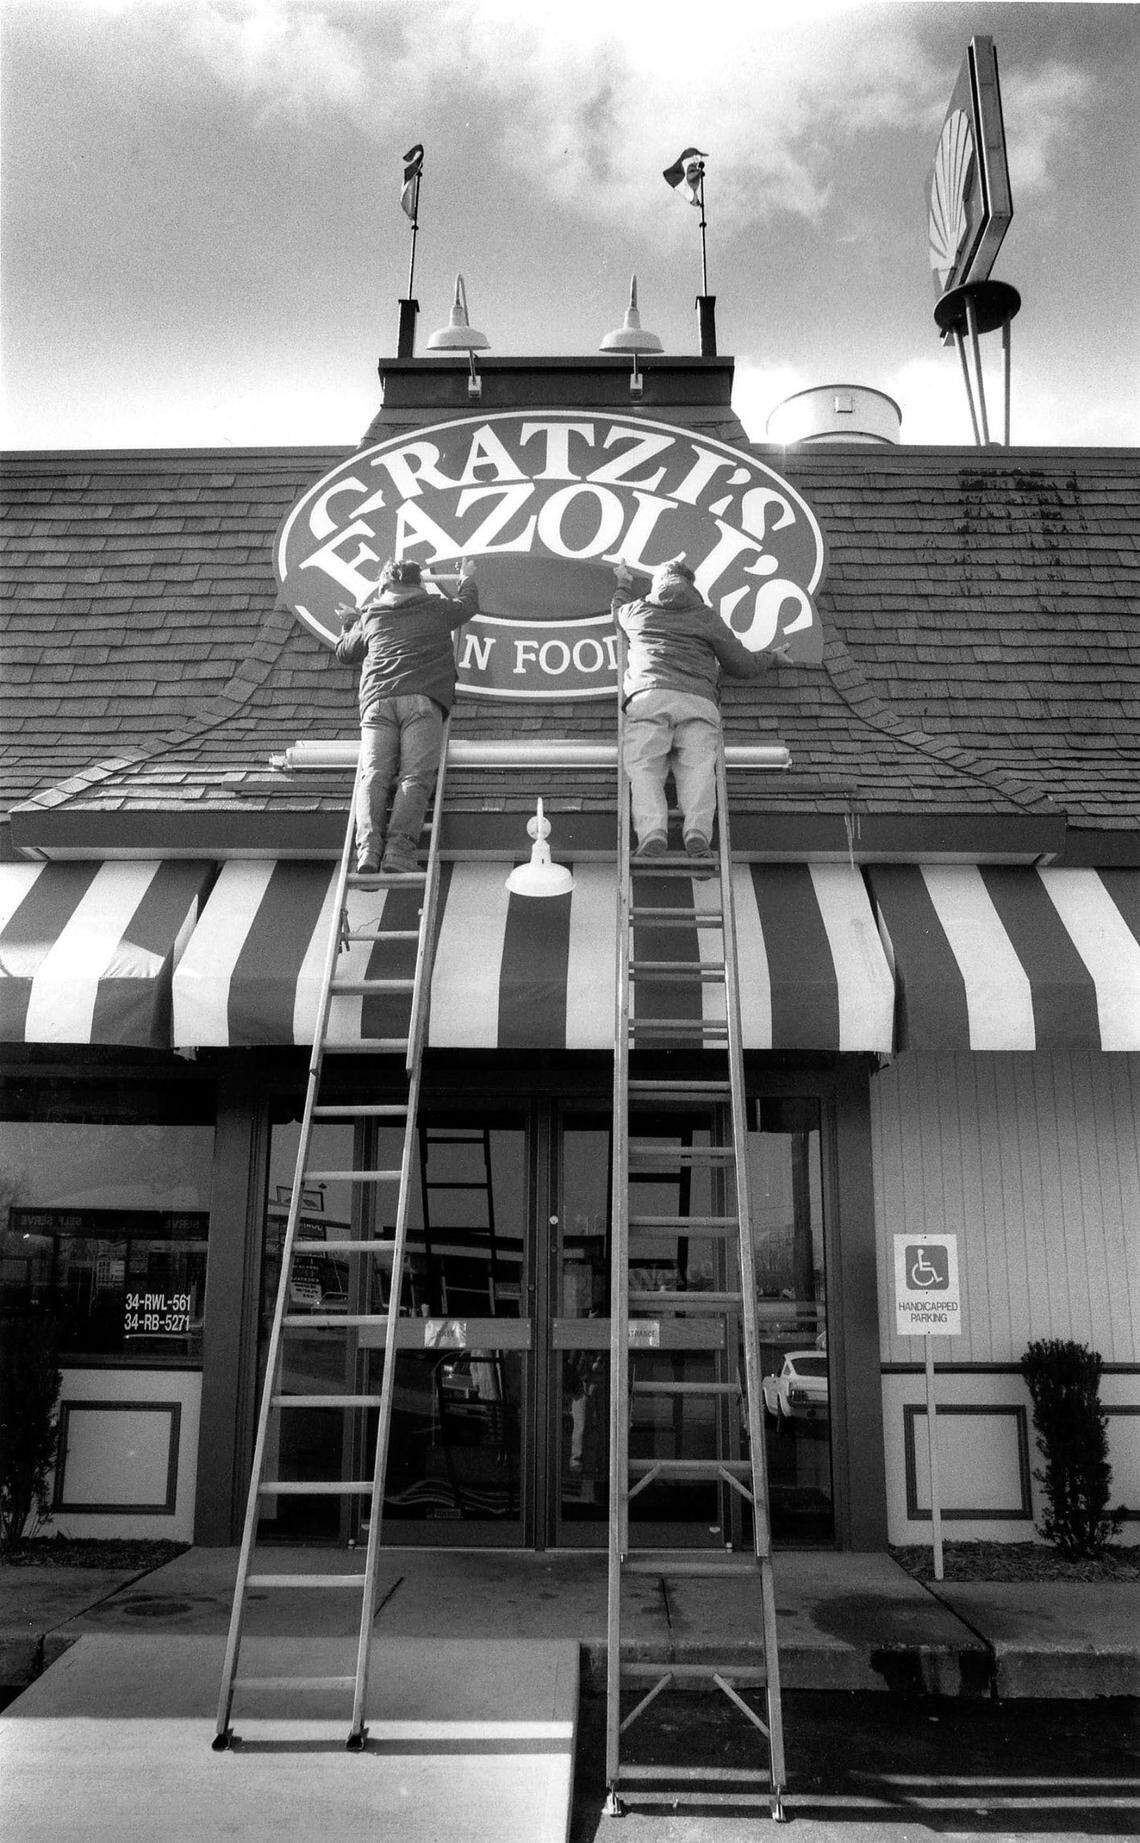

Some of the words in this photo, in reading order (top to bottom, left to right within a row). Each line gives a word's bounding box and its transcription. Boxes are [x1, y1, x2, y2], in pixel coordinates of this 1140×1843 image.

[309, 422, 796, 540] GRATZI'S
[299, 482, 813, 652] FAZOLI'S
[125, 1293, 191, 1311] 34-RWL-561
[898, 1301, 959, 1311] HANDICAPPED
[124, 1313, 190, 1331] 34-RB-5271
[910, 1313, 948, 1323] PARKING
